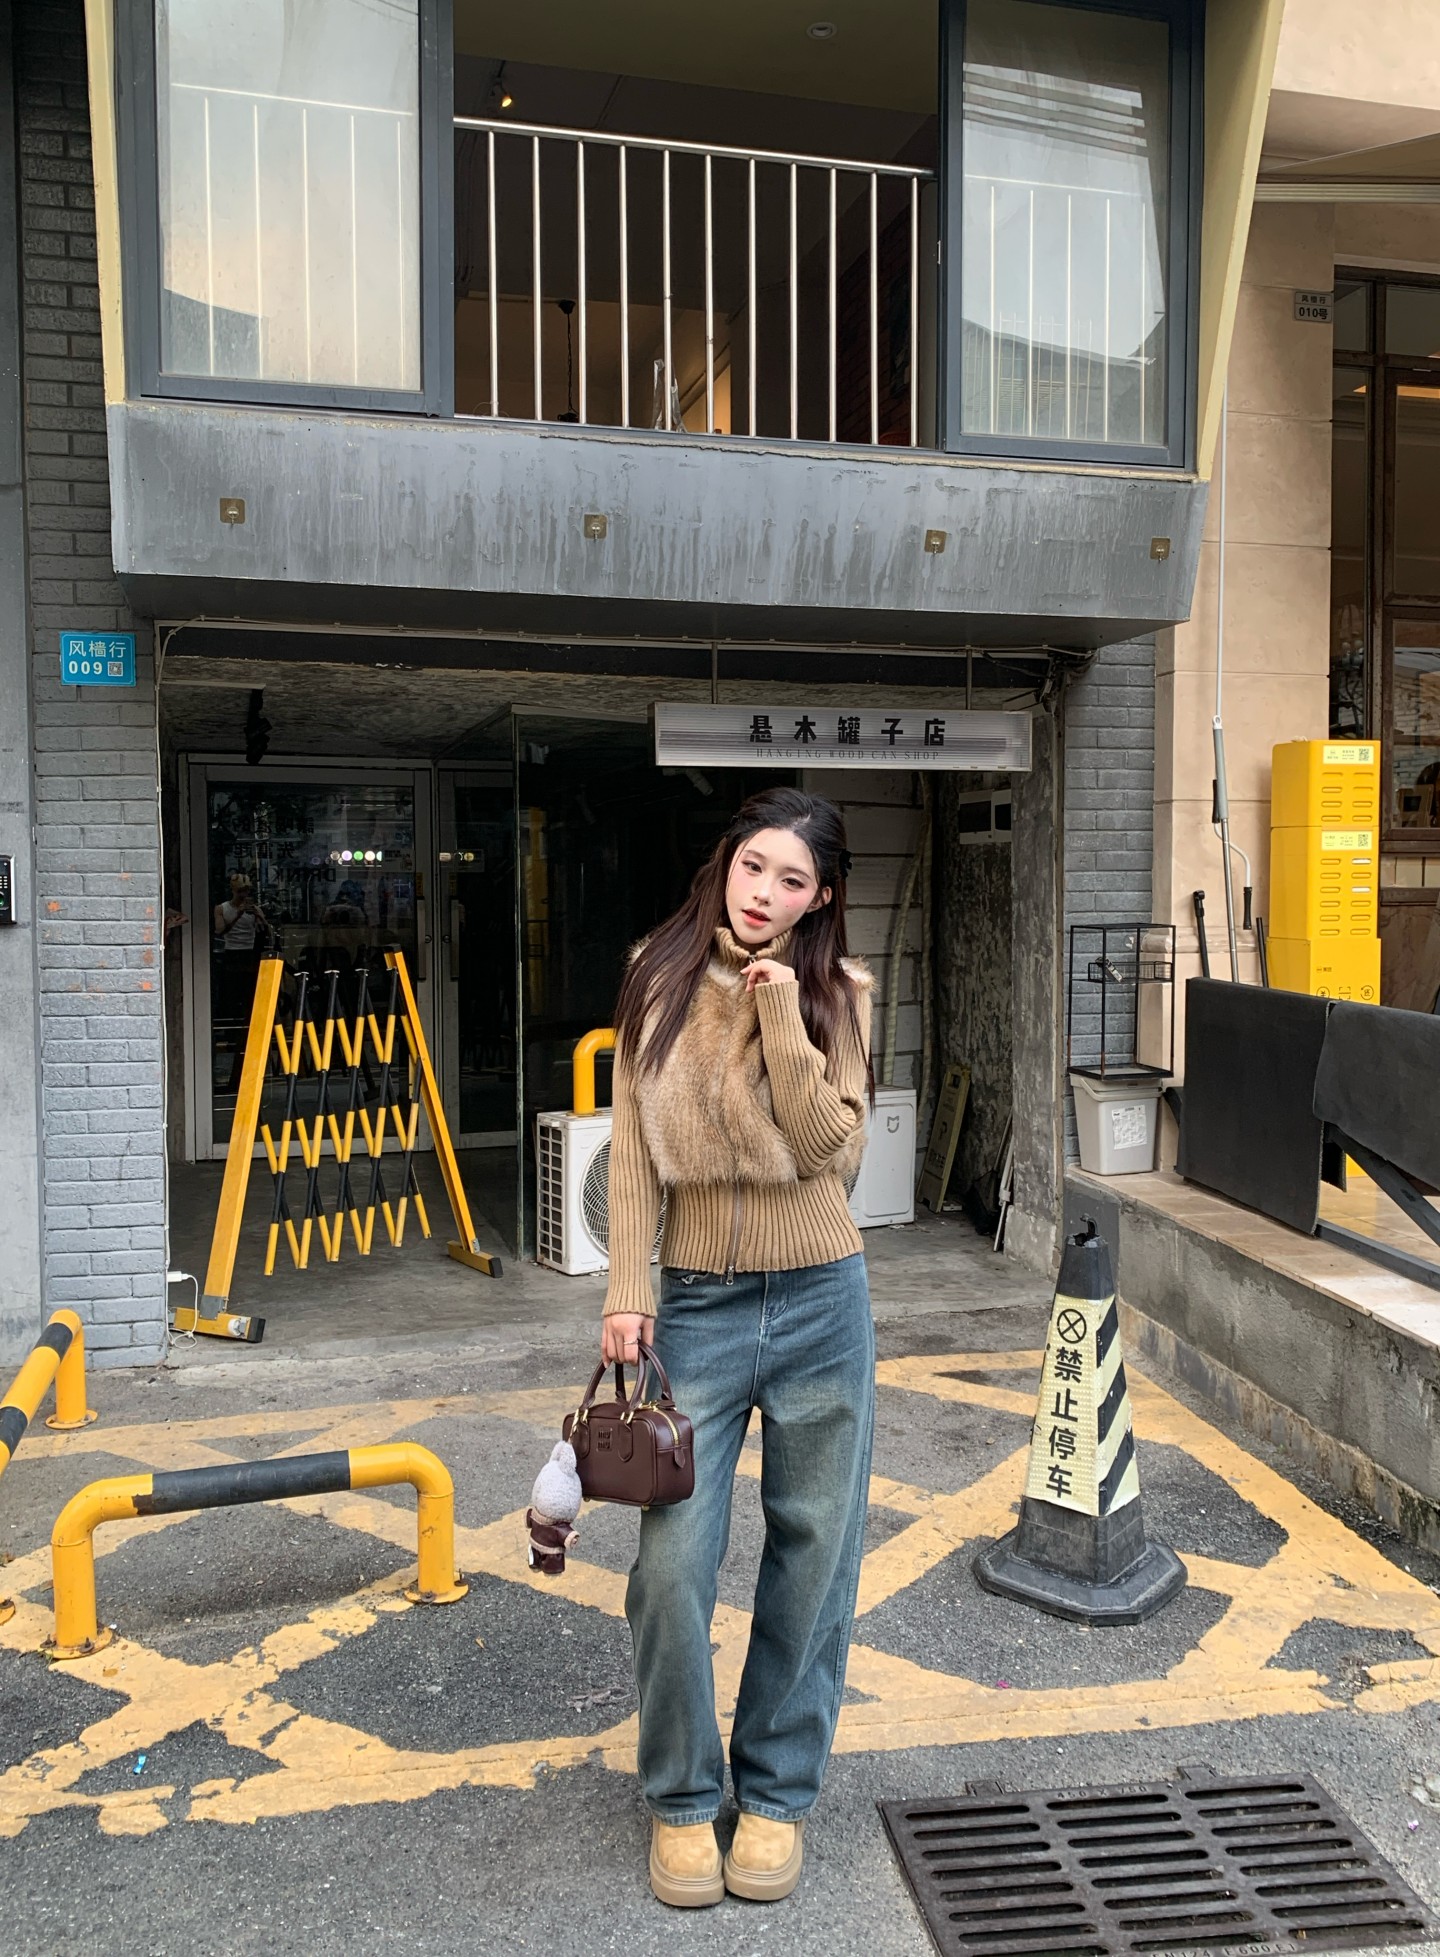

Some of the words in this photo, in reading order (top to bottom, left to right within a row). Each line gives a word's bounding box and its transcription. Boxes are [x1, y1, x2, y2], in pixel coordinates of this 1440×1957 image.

[1299, 306, 1328, 320] 010号
[69, 640, 126, 658] 风樯行
[68, 660, 103, 675] 009
[749, 714, 946, 747] 悬木罐子店
[756, 748, 821, 758] HANGING
[871, 750, 897, 760] CAN
[904, 751, 939, 760] SHOP
[1046, 1345, 1083, 1499] 禁止停车
